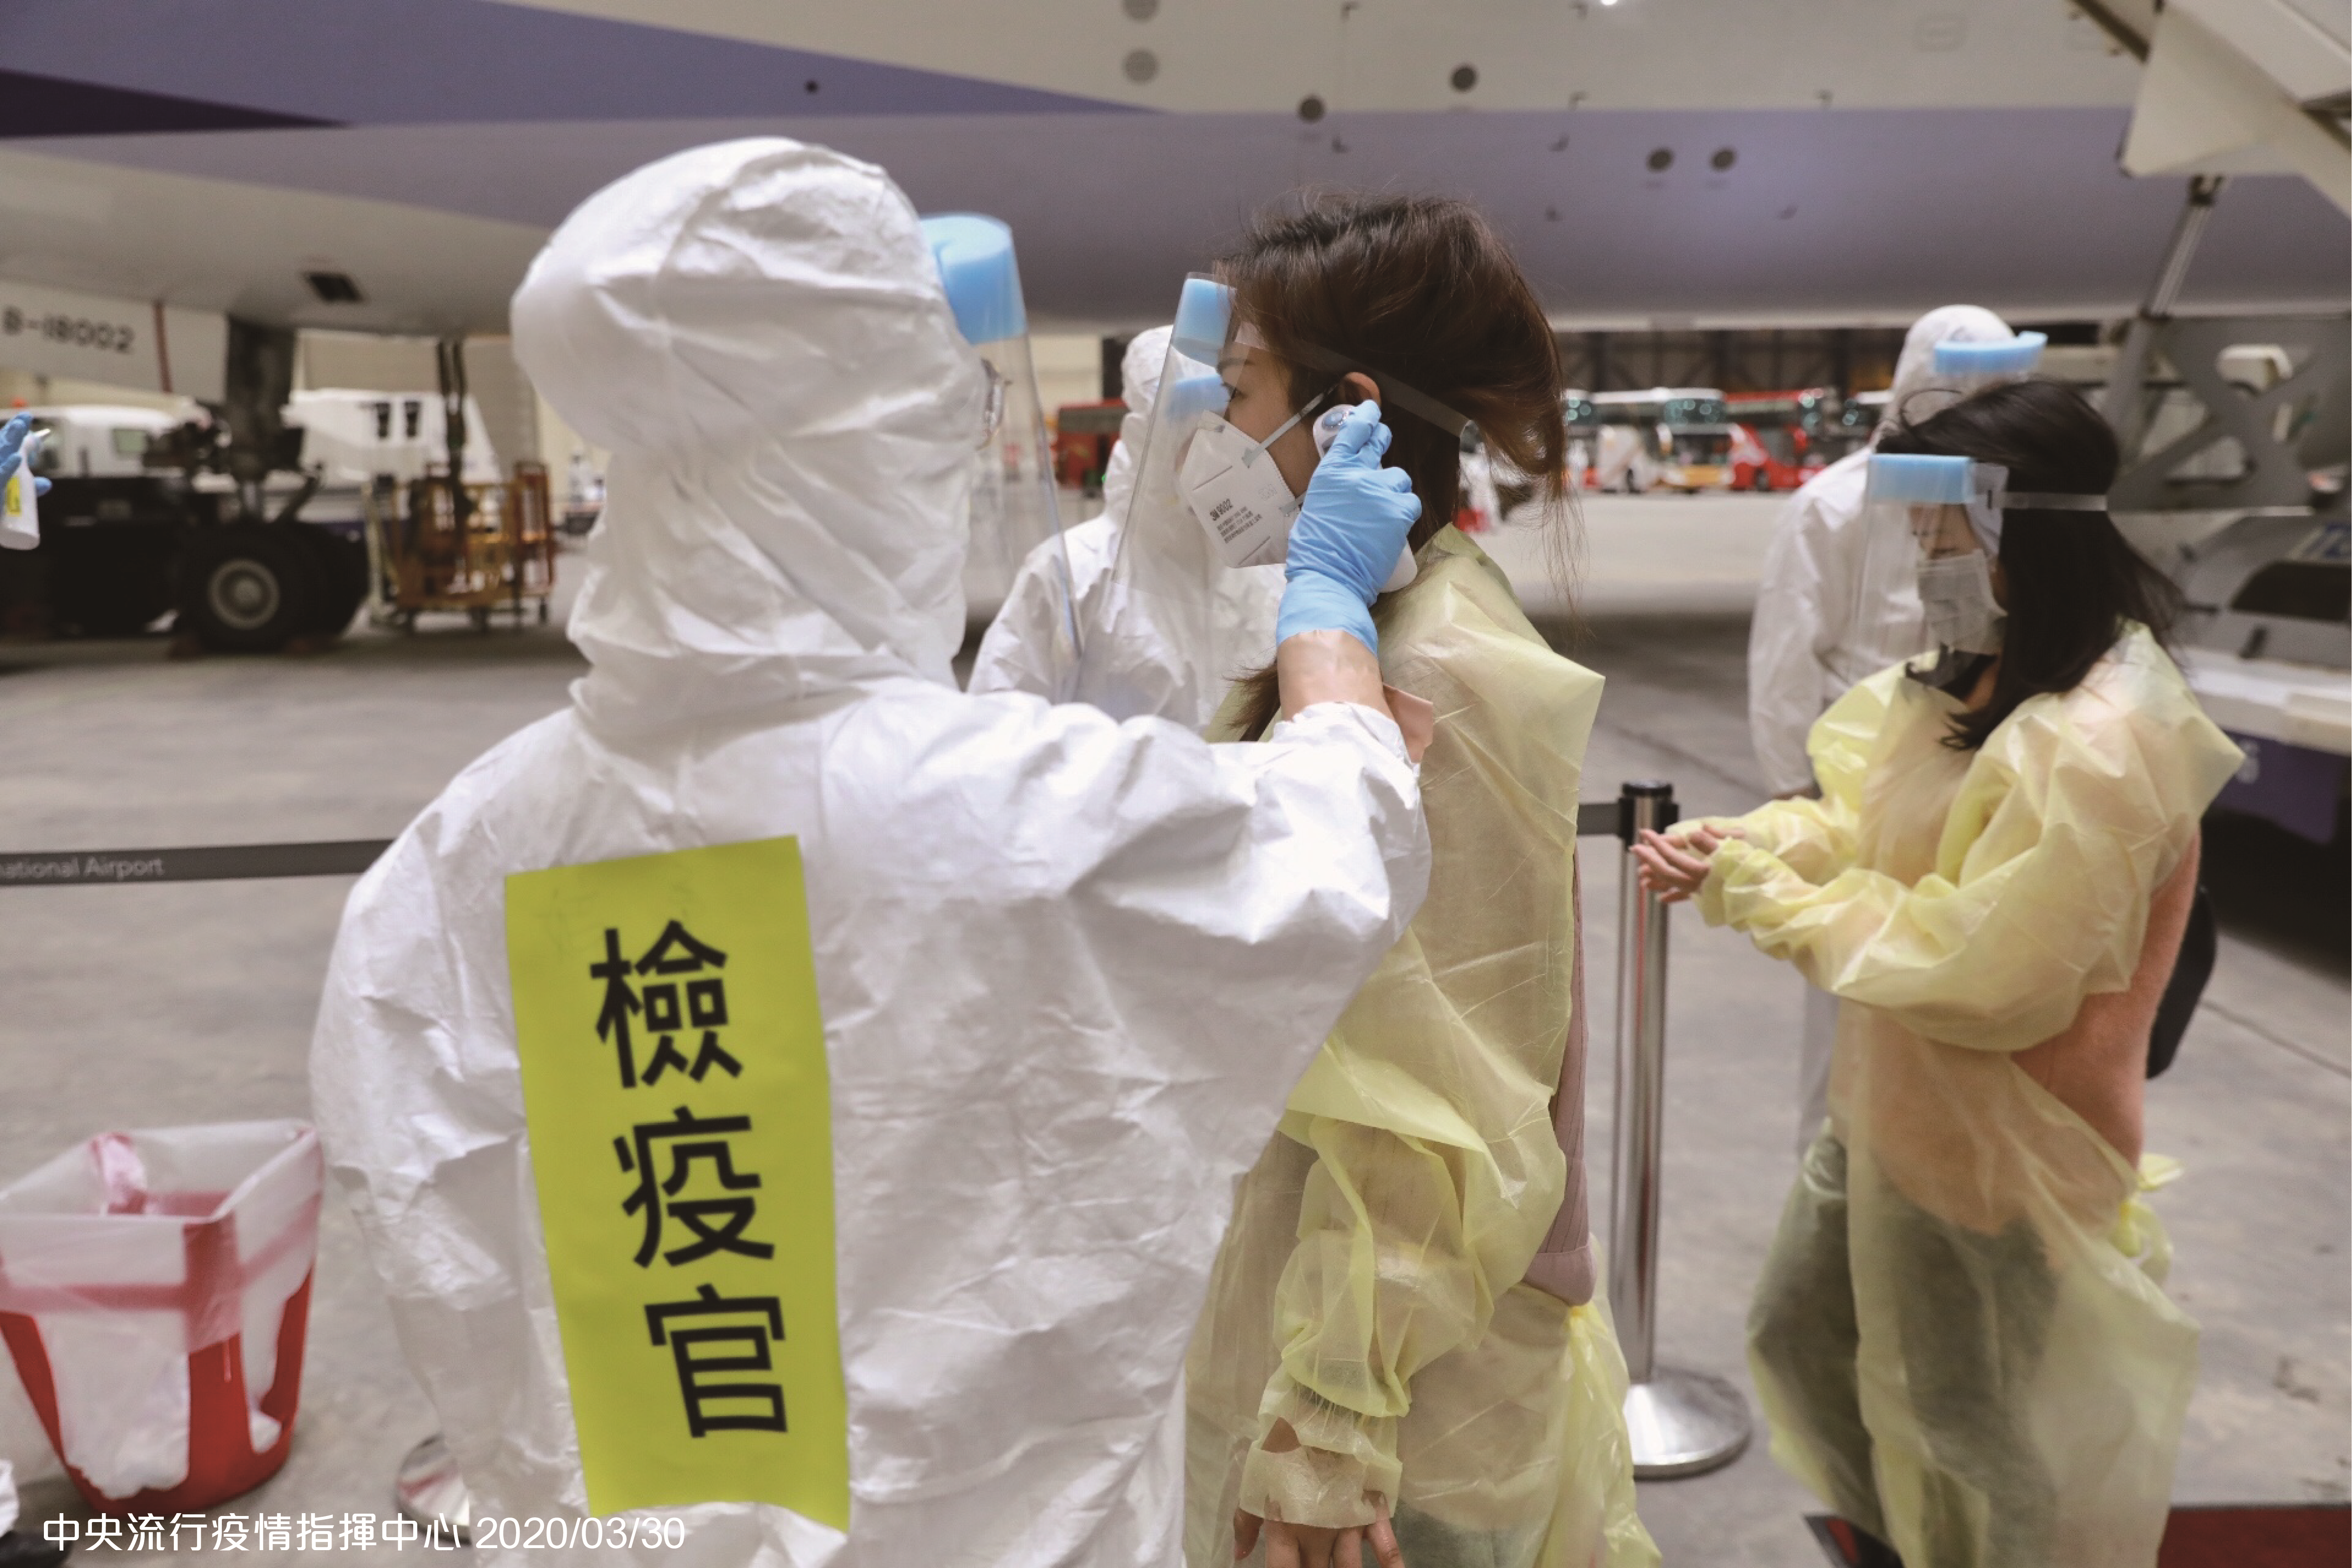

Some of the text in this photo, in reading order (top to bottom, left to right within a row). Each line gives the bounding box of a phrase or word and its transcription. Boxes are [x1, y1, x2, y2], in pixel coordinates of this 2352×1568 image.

[2, 306, 134, 354] B-18002
[84, 856, 165, 881] Airport
[590, 919, 788, 1438] 檢疫官
